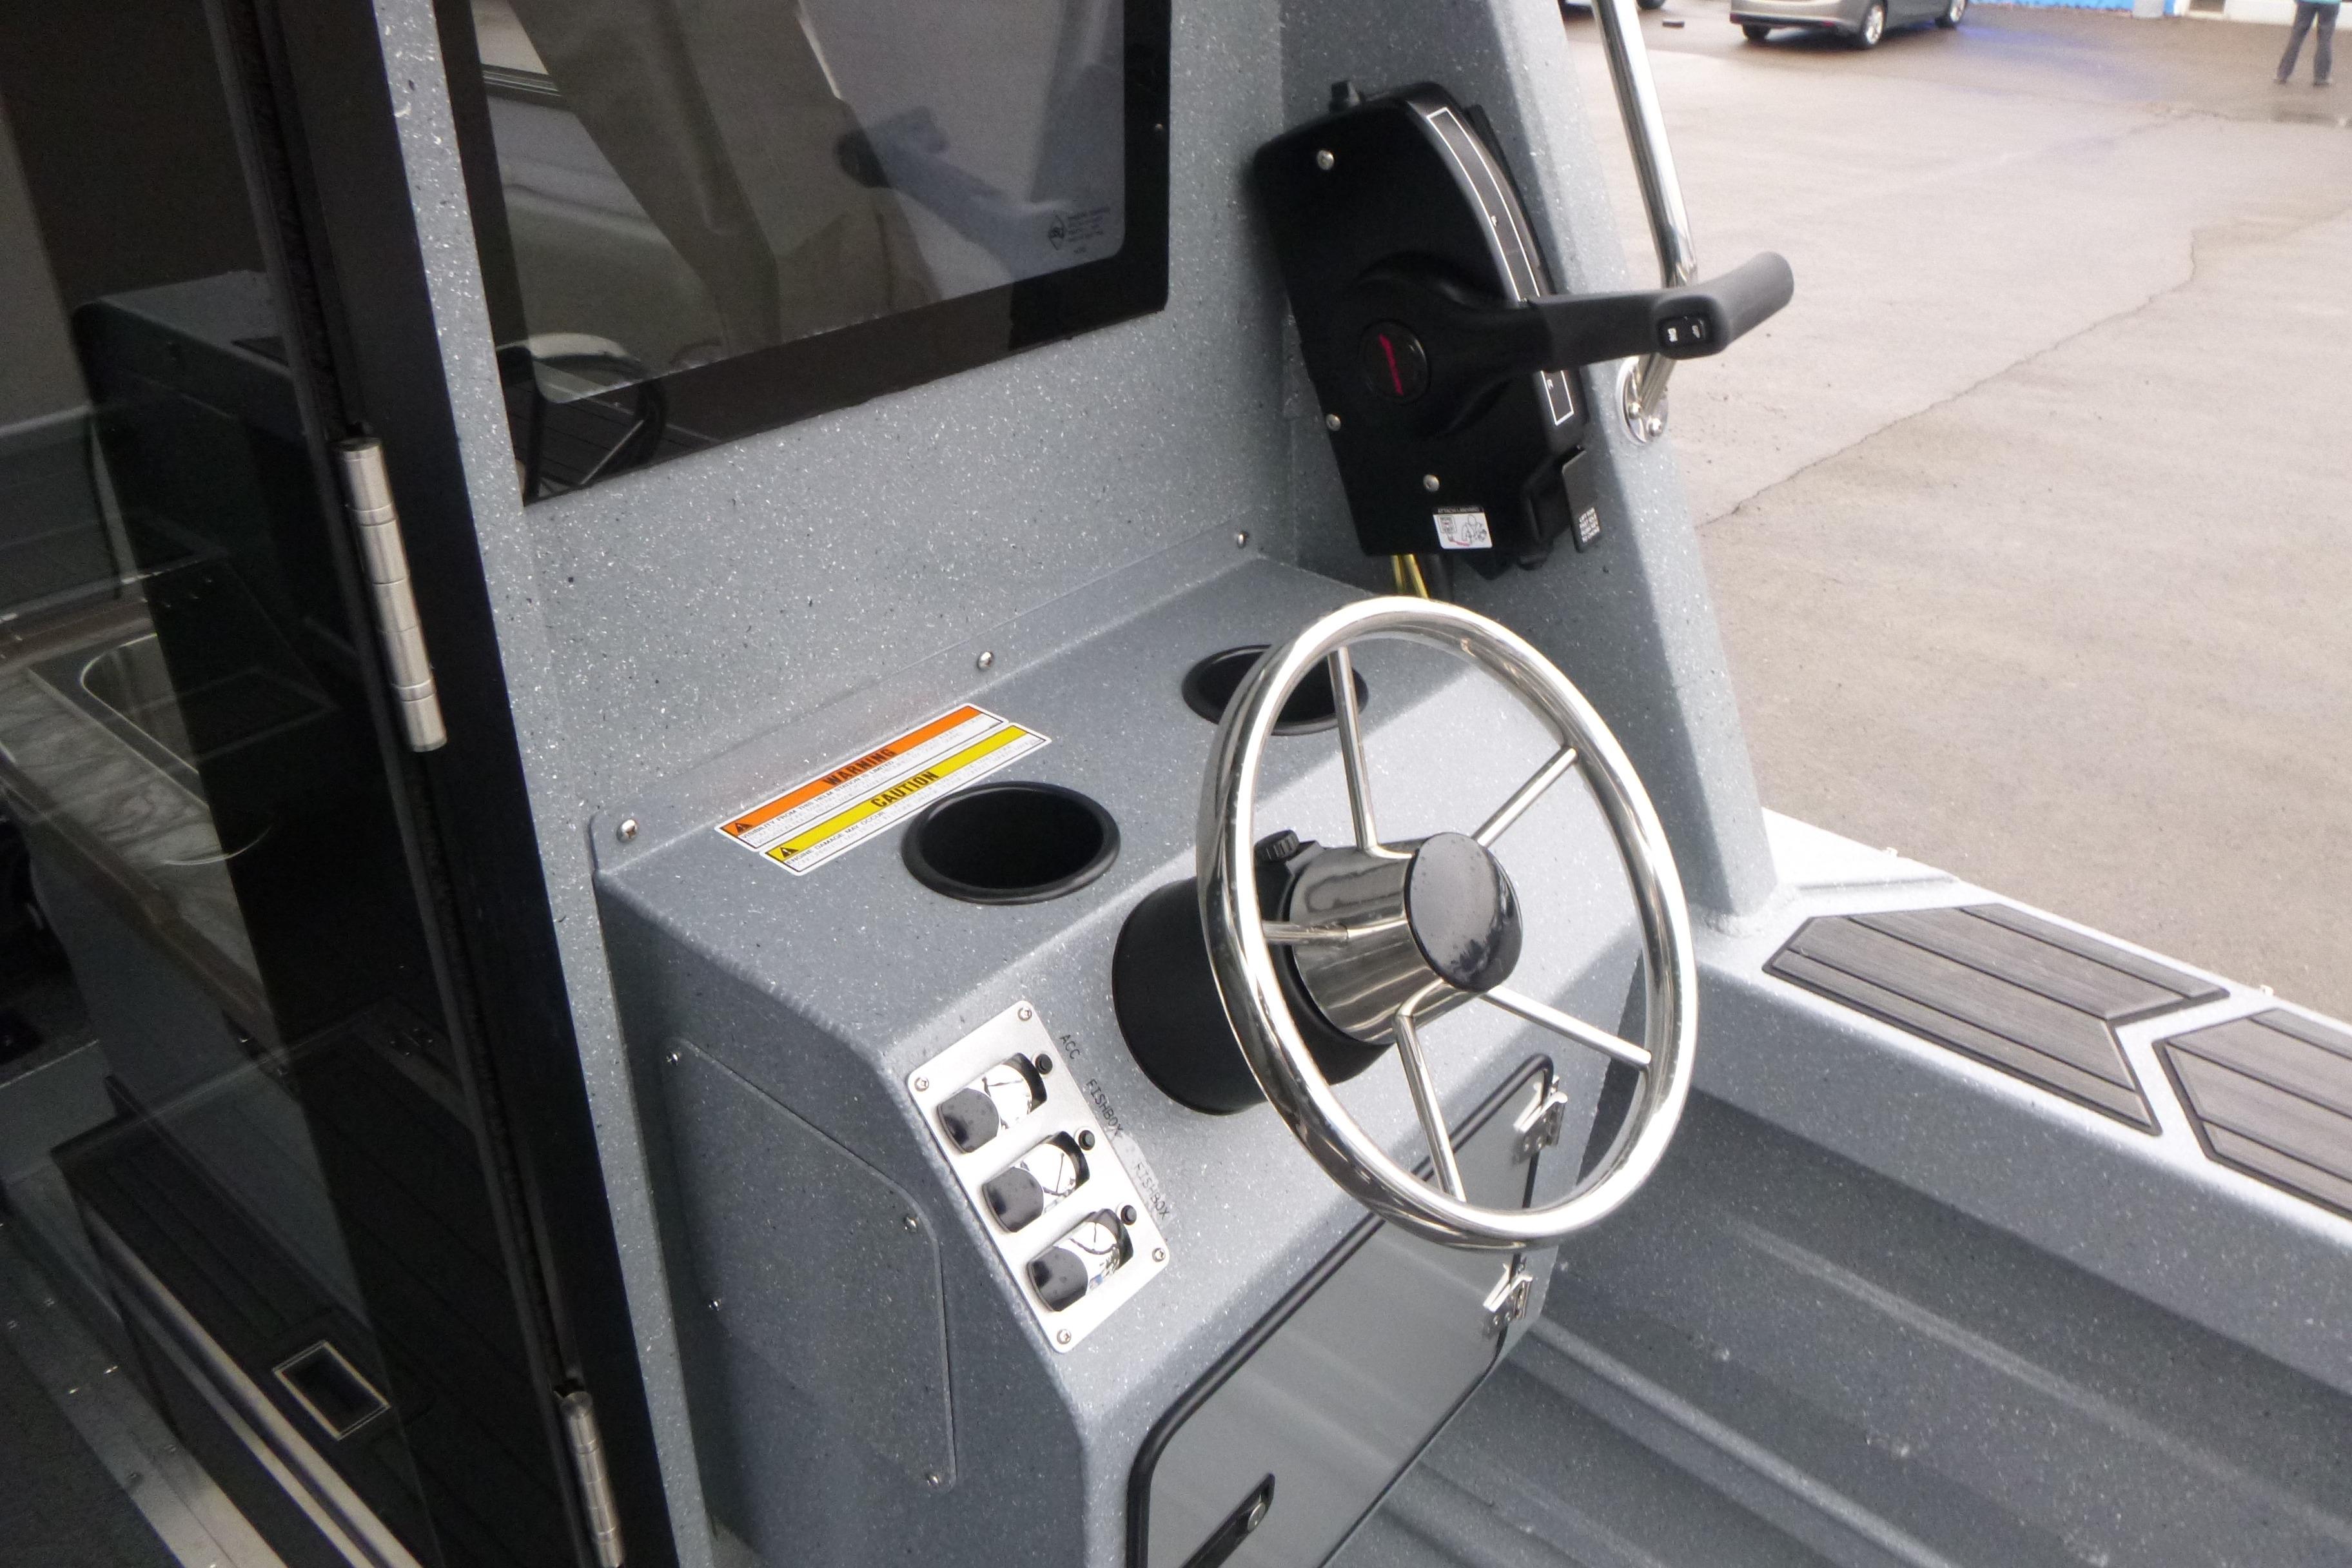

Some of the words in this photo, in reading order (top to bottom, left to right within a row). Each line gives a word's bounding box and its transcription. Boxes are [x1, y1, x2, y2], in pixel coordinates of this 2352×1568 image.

[822, 748, 897, 786] WARNING
[741, 820, 776, 838] VISIBILITY
[776, 809, 797, 821] FROM
[798, 801, 814, 810] THIS
[814, 791, 834, 802] HELM
[834, 778, 861, 792] STATION
[870, 771, 940, 807] CAUTION
[786, 848, 814, 865] ENGINE
[815, 834, 843, 850] DAMAGE
[845, 825, 860, 834] MAY
[1060, 1034, 1081, 1060] ACC
[1086, 1079, 1124, 1137] FISHBOX
[1133, 1162, 1170, 1221] FISHBOX
